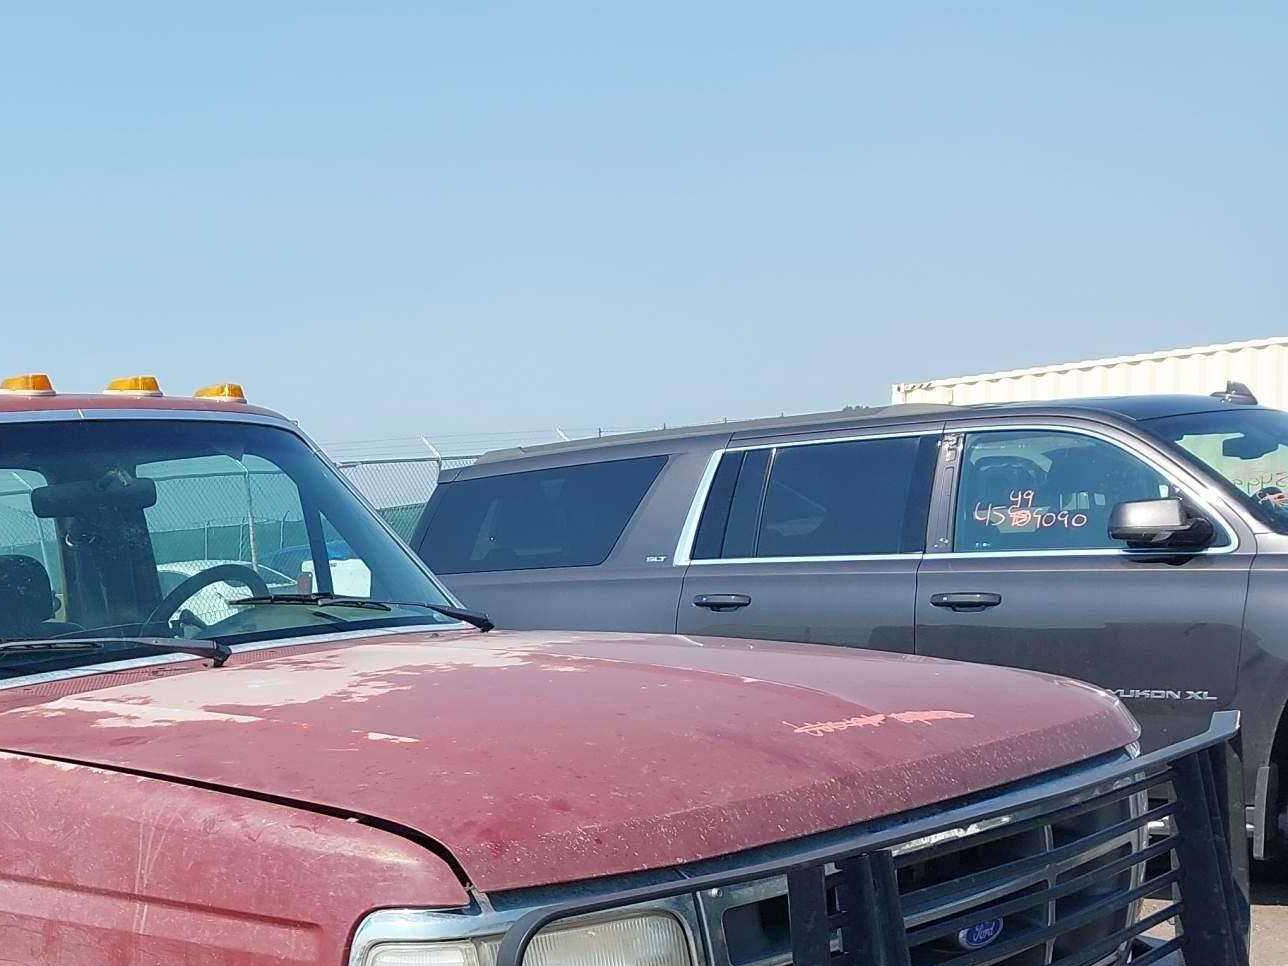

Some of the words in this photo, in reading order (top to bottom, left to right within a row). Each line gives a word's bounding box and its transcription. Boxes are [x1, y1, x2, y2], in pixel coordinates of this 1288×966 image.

[1010, 489, 1034, 508] 49
[1184, 690, 1218, 700] XL
[973, 921, 996, 942] Ford
